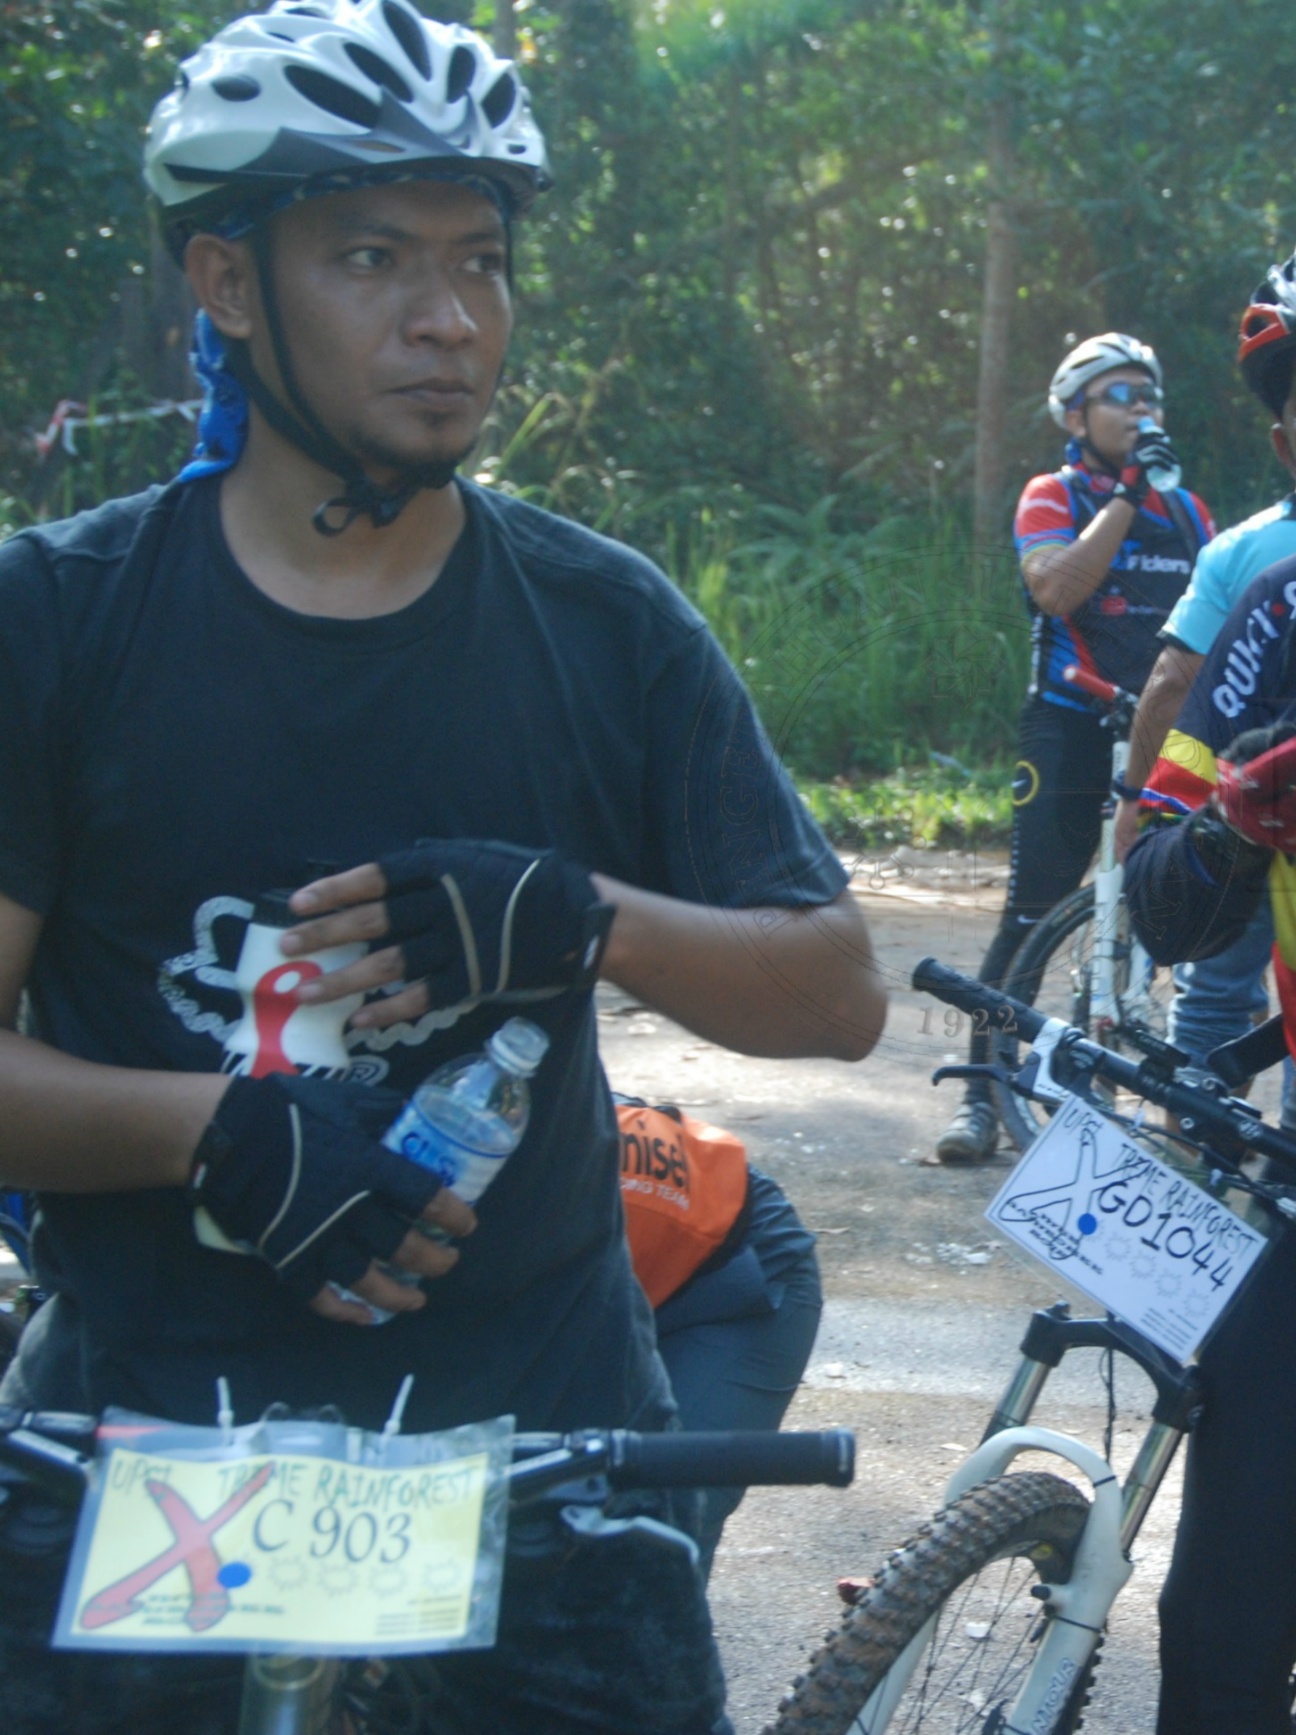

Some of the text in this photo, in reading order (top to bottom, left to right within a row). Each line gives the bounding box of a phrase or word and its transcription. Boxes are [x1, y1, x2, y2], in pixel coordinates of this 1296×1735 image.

[1097, 1180, 1234, 1292] GD1044
[253, 1499, 412, 1564] C 903
